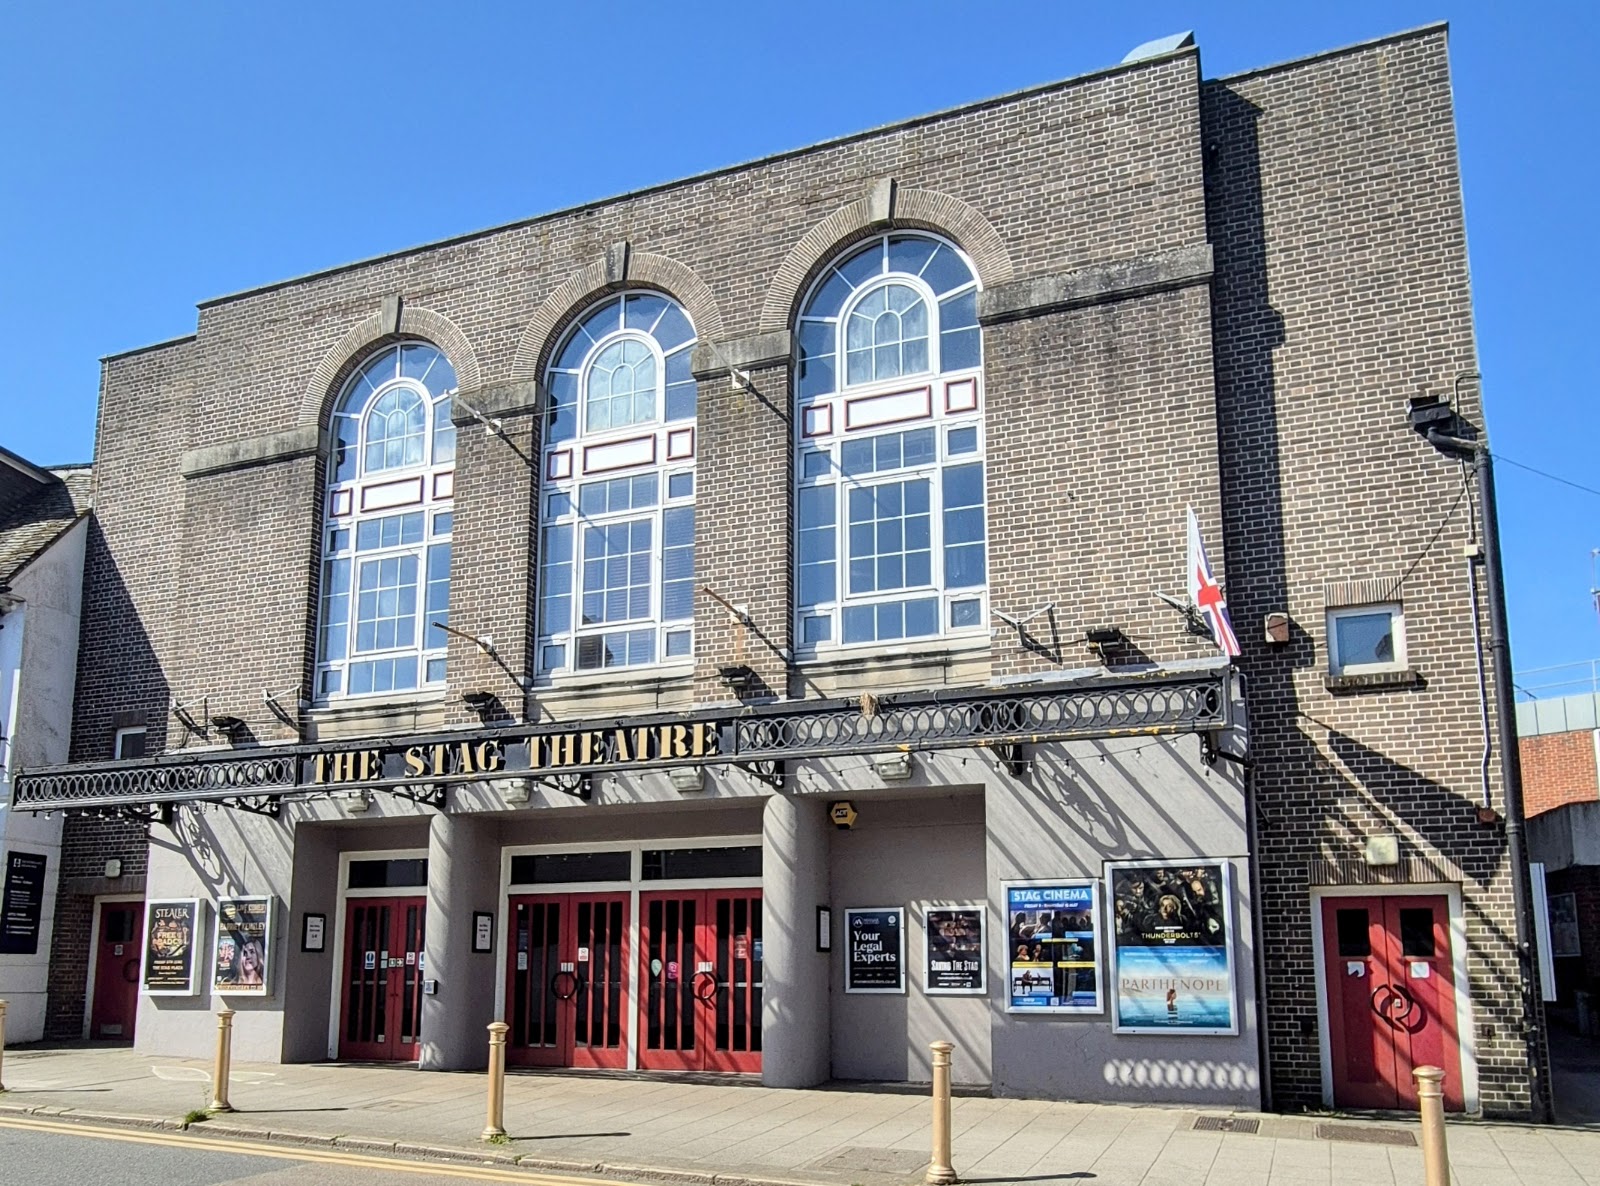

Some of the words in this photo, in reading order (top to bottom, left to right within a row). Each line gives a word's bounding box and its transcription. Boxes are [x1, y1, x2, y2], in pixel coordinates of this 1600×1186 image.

[311, 749, 385, 784] THE
[404, 739, 503, 778] STAG
[524, 722, 720, 769] THEATRE
[1014, 890, 1041, 901] STAG
[1043, 890, 1089, 900] CINEMA
[155, 908, 190, 919] STEALER
[853, 930, 880, 941] Your
[853, 940, 883, 953] Legal
[853, 952, 896, 964] Experts
[952, 960, 963, 971] THE
[964, 960, 978, 971] STAG
[1122, 977, 1223, 992] PARTHENOPE
